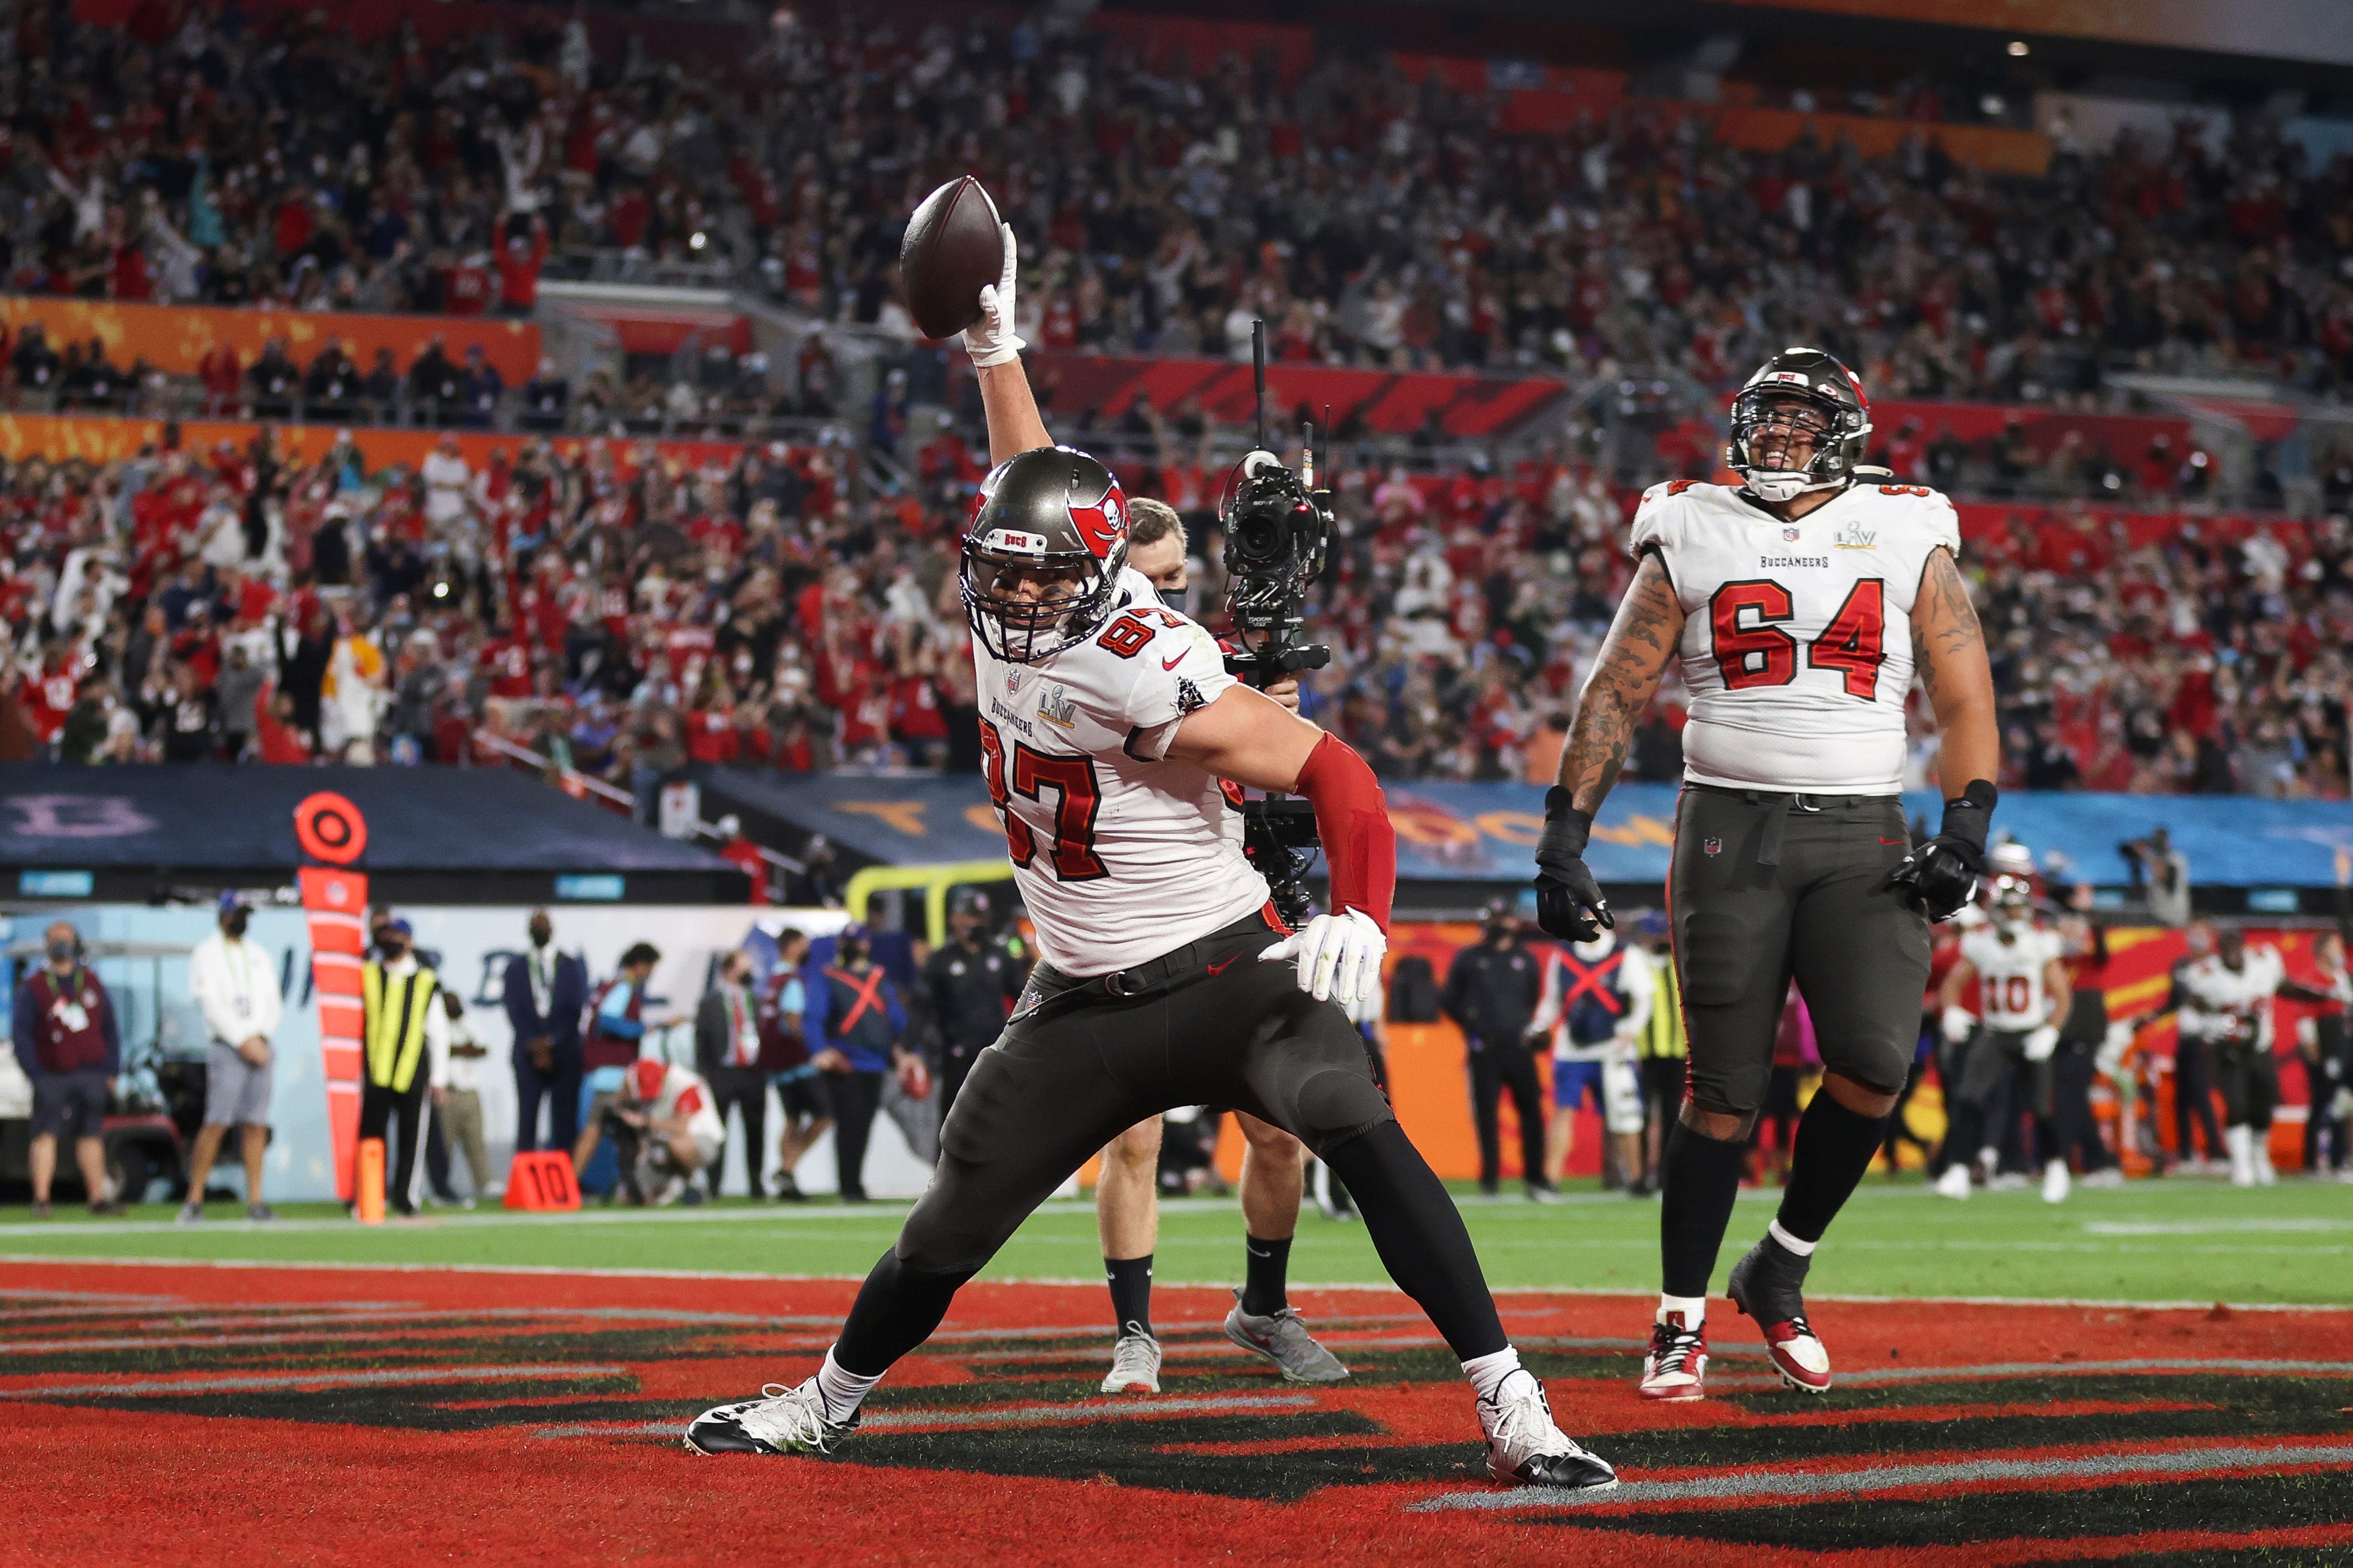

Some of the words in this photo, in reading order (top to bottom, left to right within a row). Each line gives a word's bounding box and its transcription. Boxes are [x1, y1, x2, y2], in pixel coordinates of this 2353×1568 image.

[1760, 556, 1829, 569] BUCCANEERS
[1096, 608, 1188, 659] 87
[1708, 578, 1887, 702] 64
[991, 696, 1033, 738] BUCCANEERS
[1982, 975, 2029, 1014] 10
[528, 1163, 568, 1204] 10
